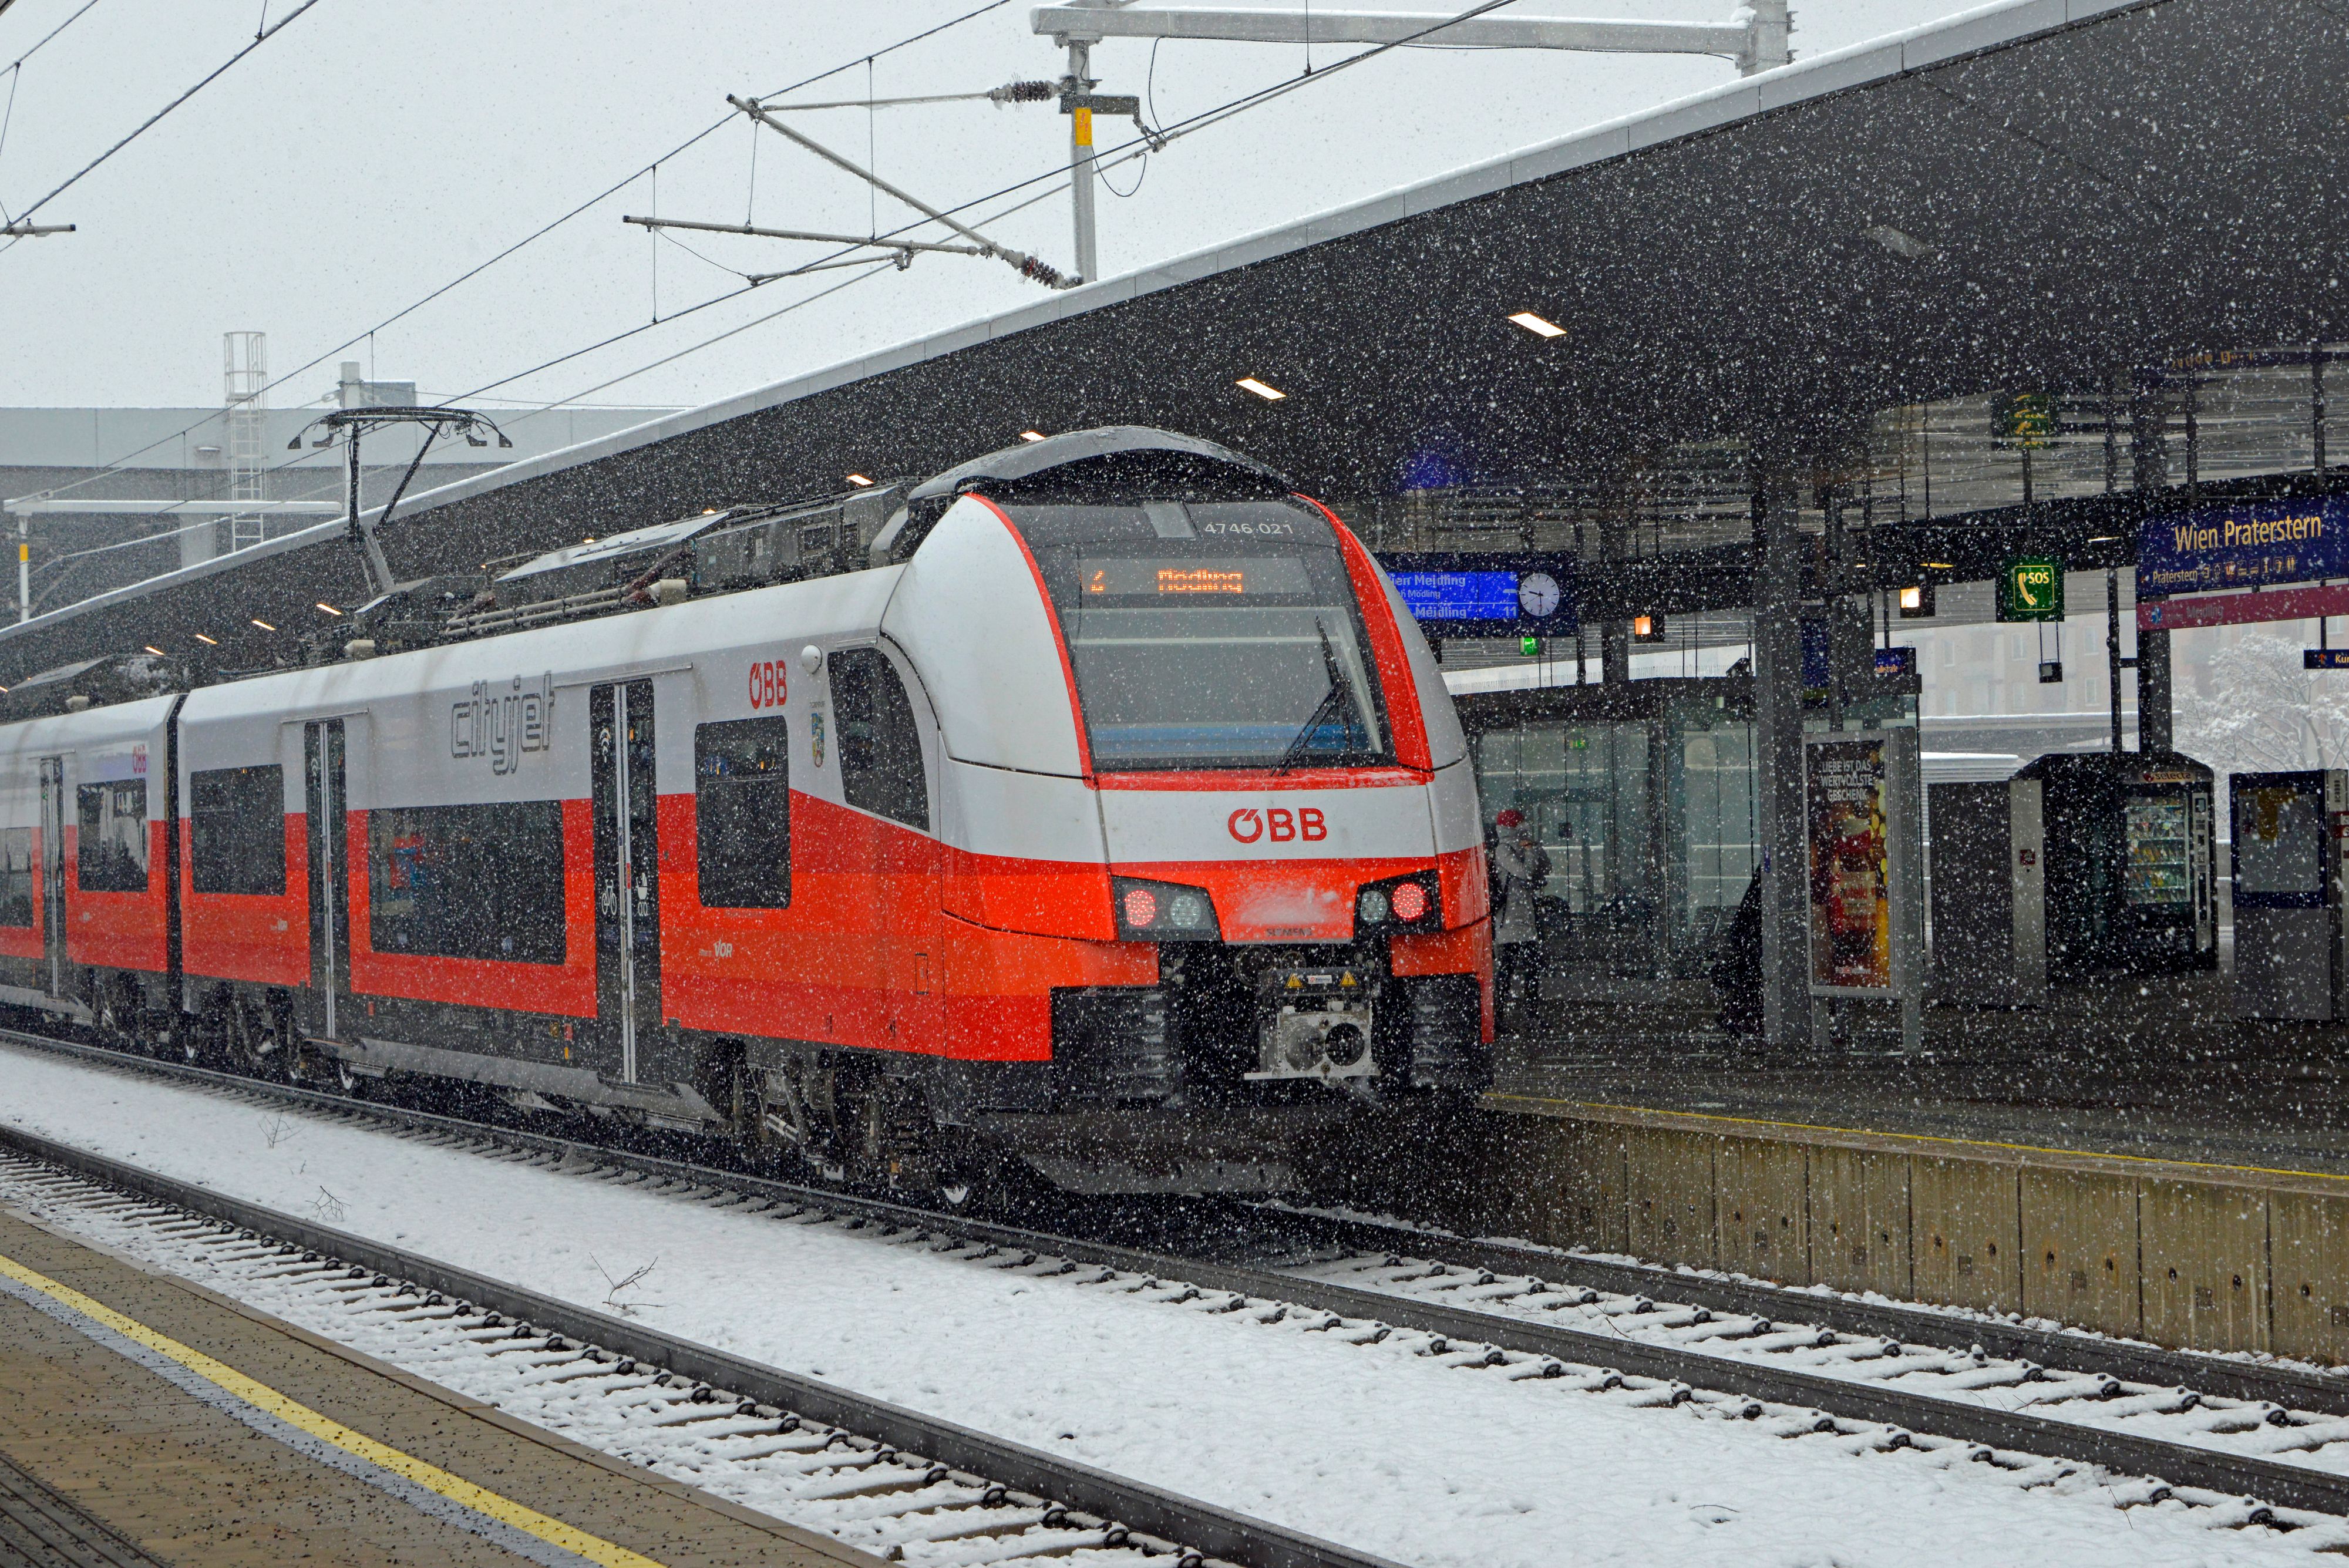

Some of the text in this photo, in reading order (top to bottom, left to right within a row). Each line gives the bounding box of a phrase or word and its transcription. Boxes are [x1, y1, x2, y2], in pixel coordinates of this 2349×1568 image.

[1204, 523, 1294, 534] 4746 021
[2175, 515, 2321, 552] Wien Praterstern
[1389, 574, 1466, 587] ien Meidling
[2028, 571, 2050, 584] SOS
[2153, 569, 2197, 584] Praterstern
[1415, 606, 1517, 617] Meidling 11
[749, 659, 788, 709] ÖBB
[451, 669, 556, 776] cityjet
[1822, 759, 1872, 772] LIEBE IST DAS
[1821, 774, 1875, 787] WERTVOLLSTE
[2155, 772, 2191, 780] selecta
[1227, 807, 1328, 844] ÖBB
[714, 939, 733, 958] VOR
